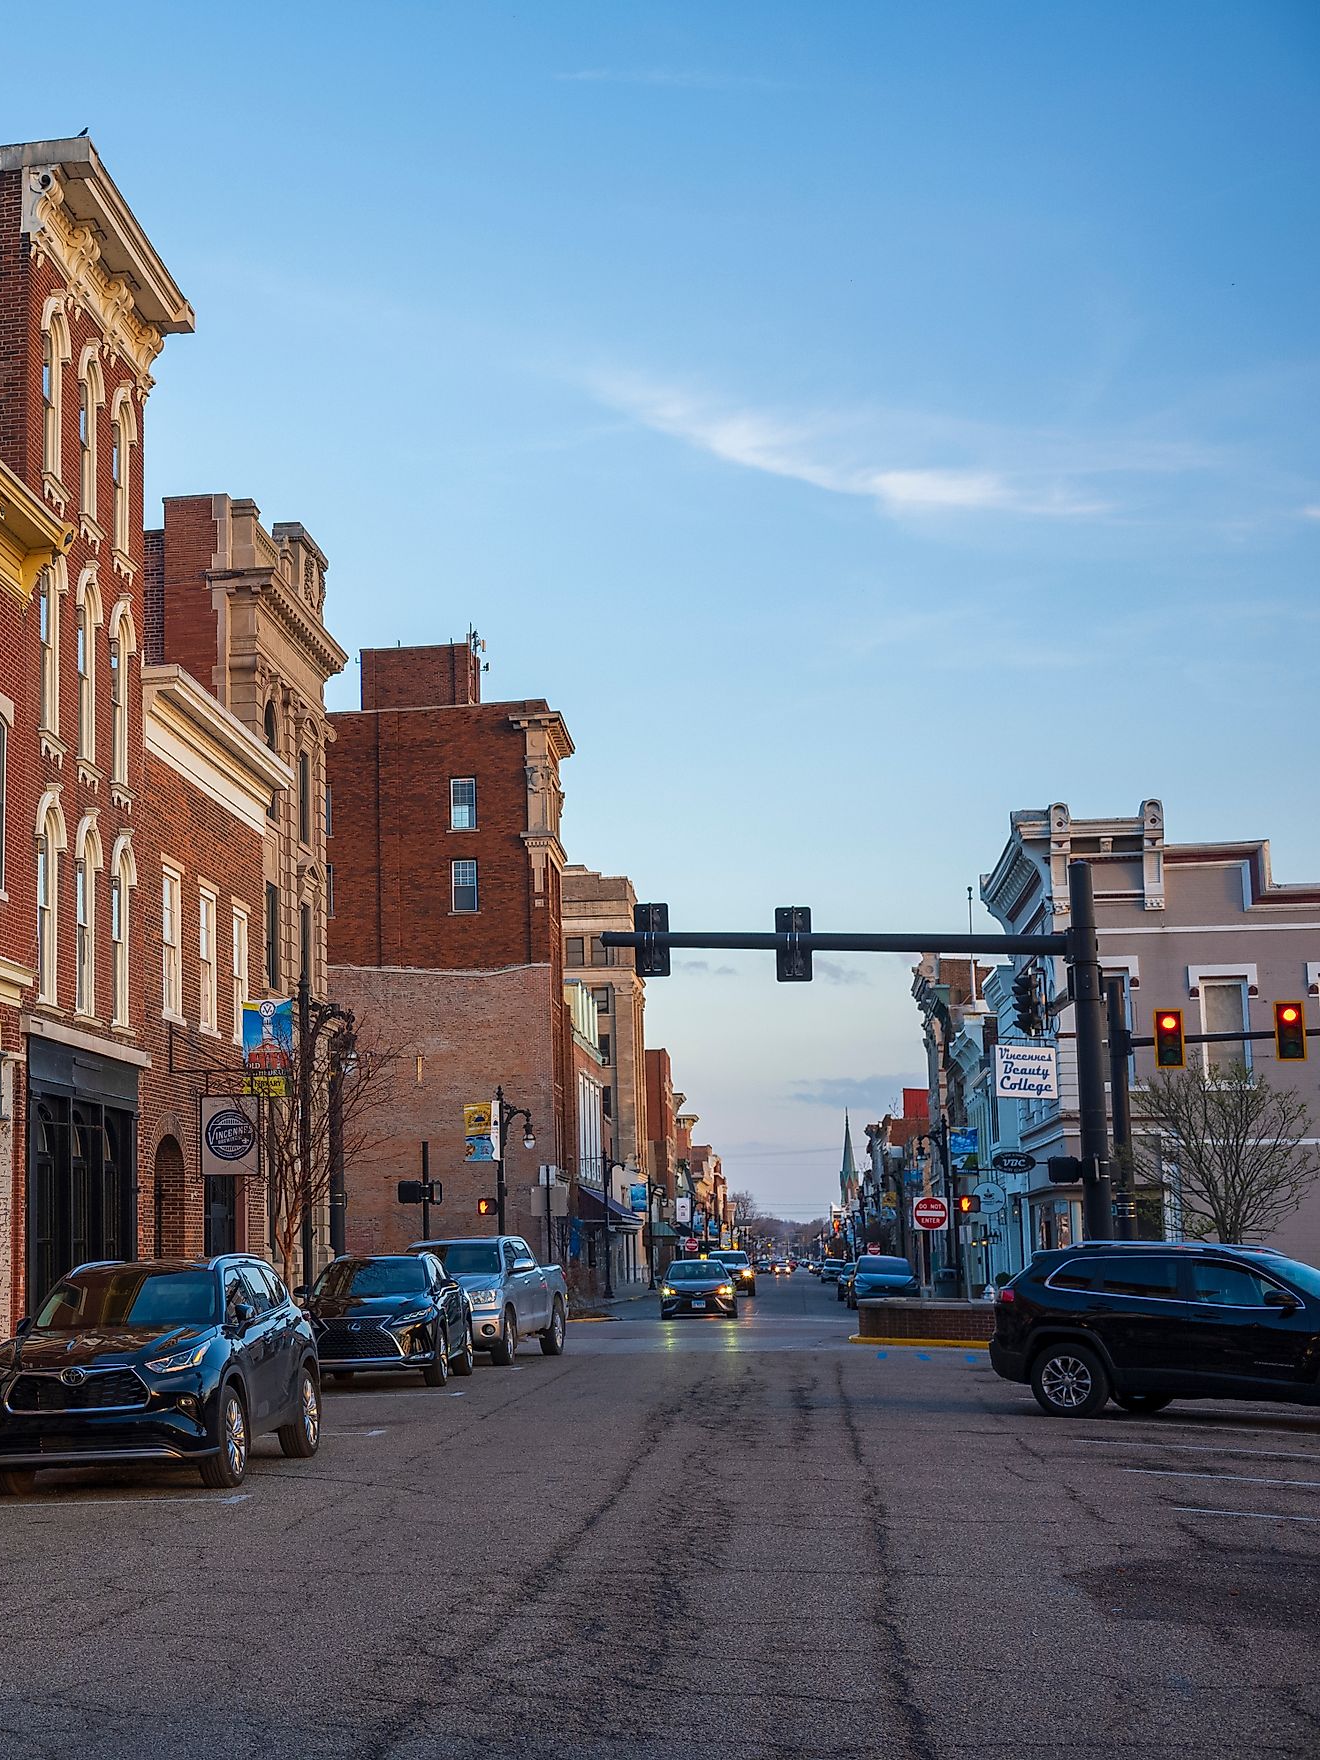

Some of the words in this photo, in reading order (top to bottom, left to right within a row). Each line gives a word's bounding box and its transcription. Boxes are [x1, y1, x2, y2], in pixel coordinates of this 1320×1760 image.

[998, 1047, 1053, 1062] Vincennes
[1002, 1060, 1050, 1080] Beauty
[1000, 1075, 1053, 1096] College
[208, 1125, 253, 1145] VINCENNES
[1002, 1158, 1026, 1167] VBC
